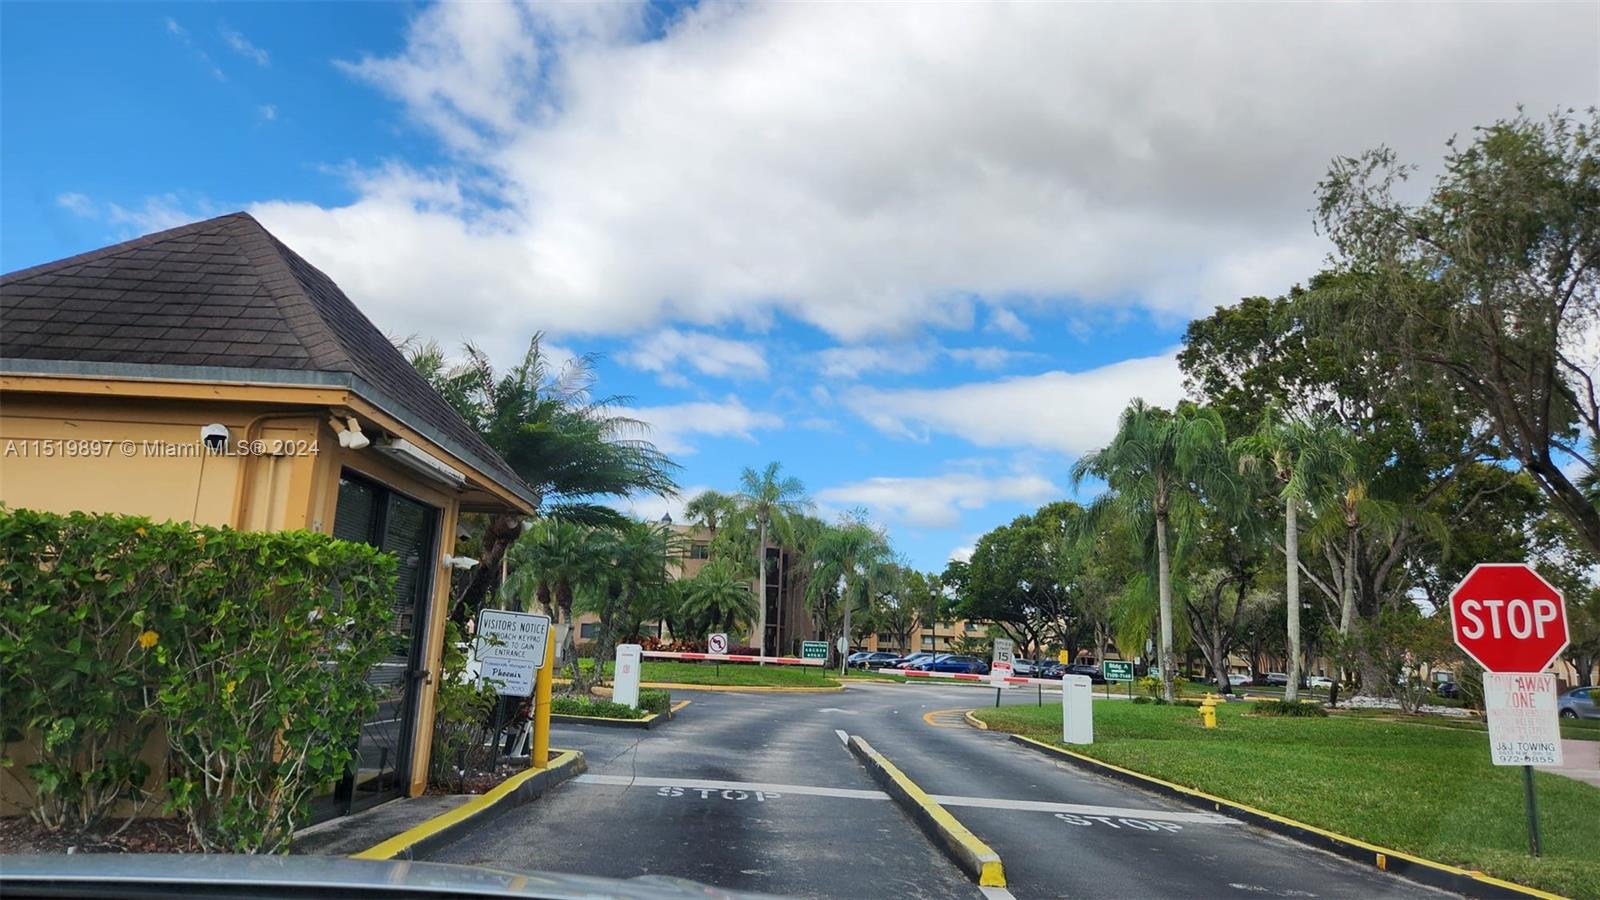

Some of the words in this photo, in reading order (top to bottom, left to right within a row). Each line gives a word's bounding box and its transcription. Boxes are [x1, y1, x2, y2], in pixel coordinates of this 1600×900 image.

[483, 619, 517, 632] VISITORS
[520, 622, 546, 635] NOTICE
[1460, 599, 1557, 640] STOP
[494, 648, 527, 658] ENTRANCE
[998, 651, 1009, 661] 15
[492, 667, 522, 679] Phoenix
[1518, 676, 1552, 692] AWAY
[1496, 742, 1513, 751] J&J
[1517, 742, 1555, 752] TOWING
[656, 786, 781, 801] STOP
[1055, 813, 1183, 833] STOP
